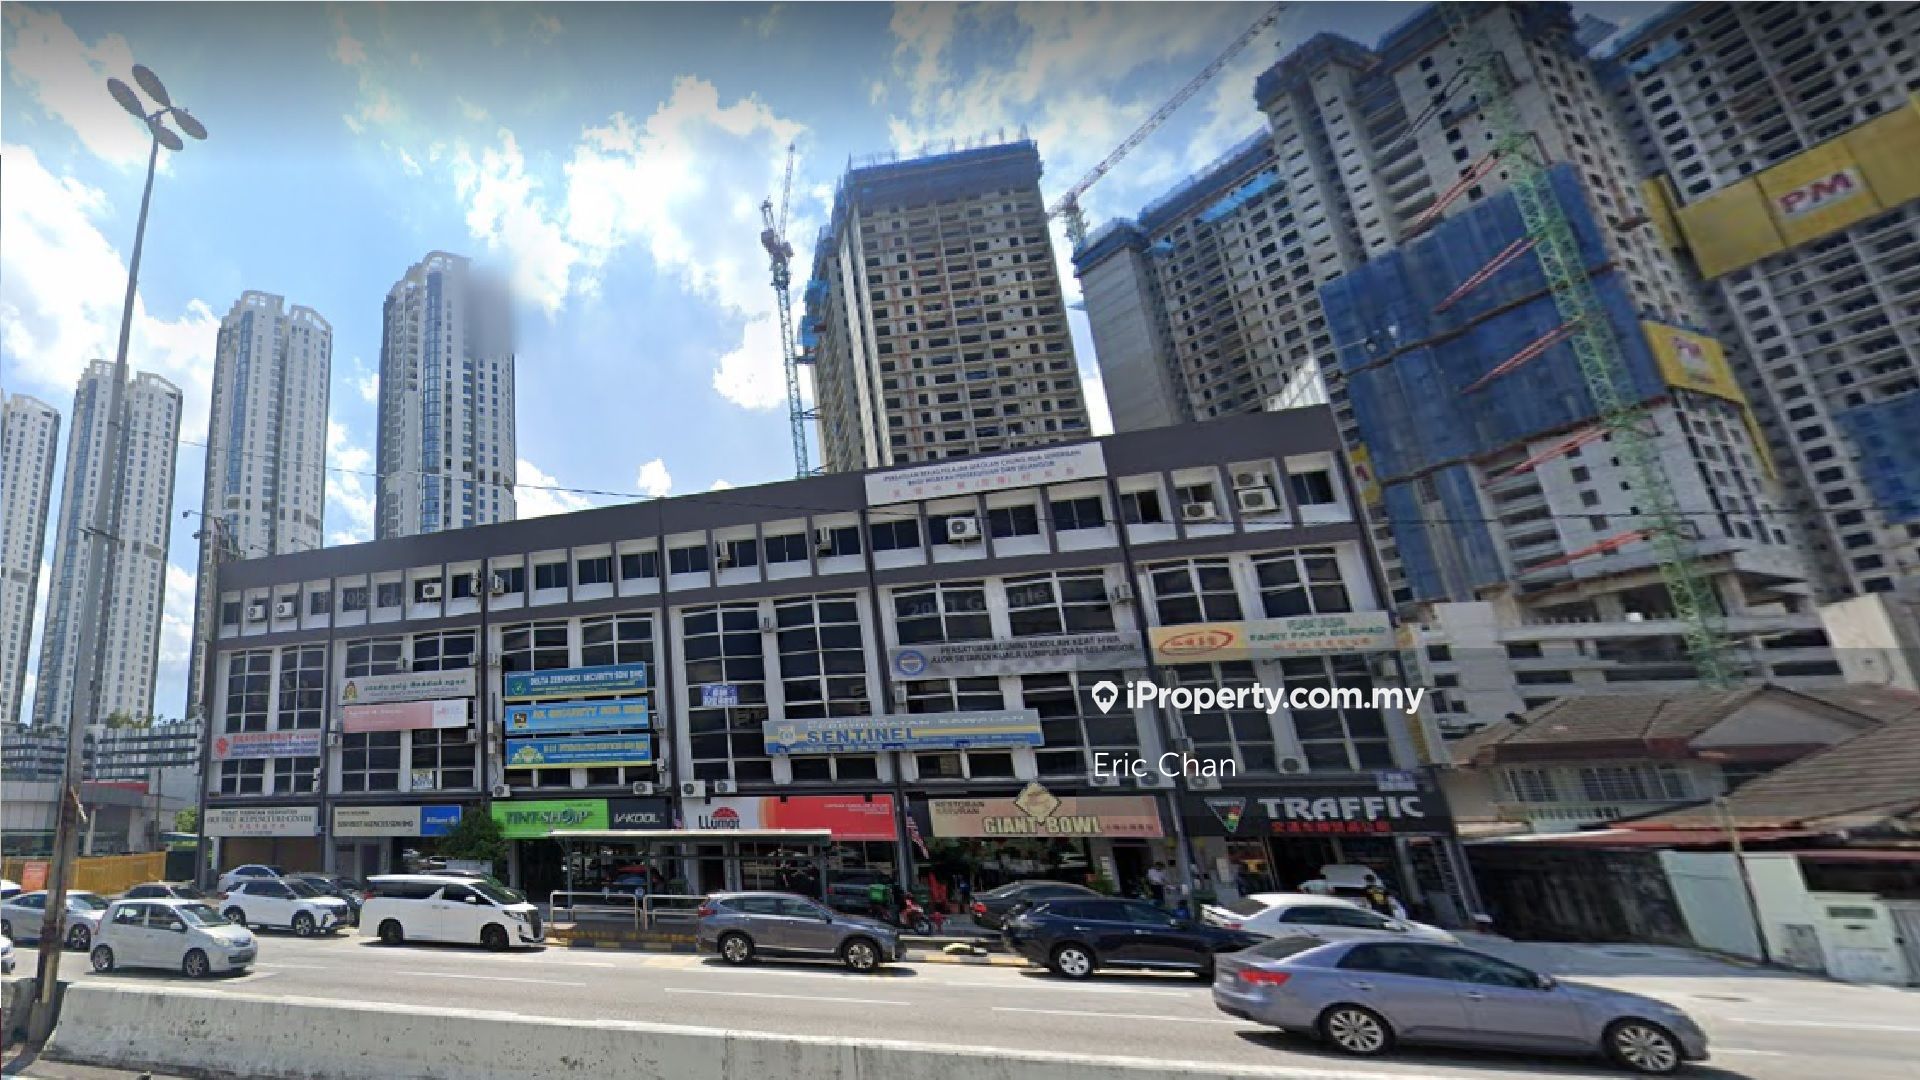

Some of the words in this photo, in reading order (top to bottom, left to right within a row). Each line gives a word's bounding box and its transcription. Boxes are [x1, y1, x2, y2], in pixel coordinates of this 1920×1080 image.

[1780, 172, 1854, 214] PM
[807, 728, 918, 745] SENTINEL
[1258, 797, 1425, 820] TRAFFIC
[984, 816, 1038, 834] GIANT
[1047, 815, 1103, 833] BOWL
